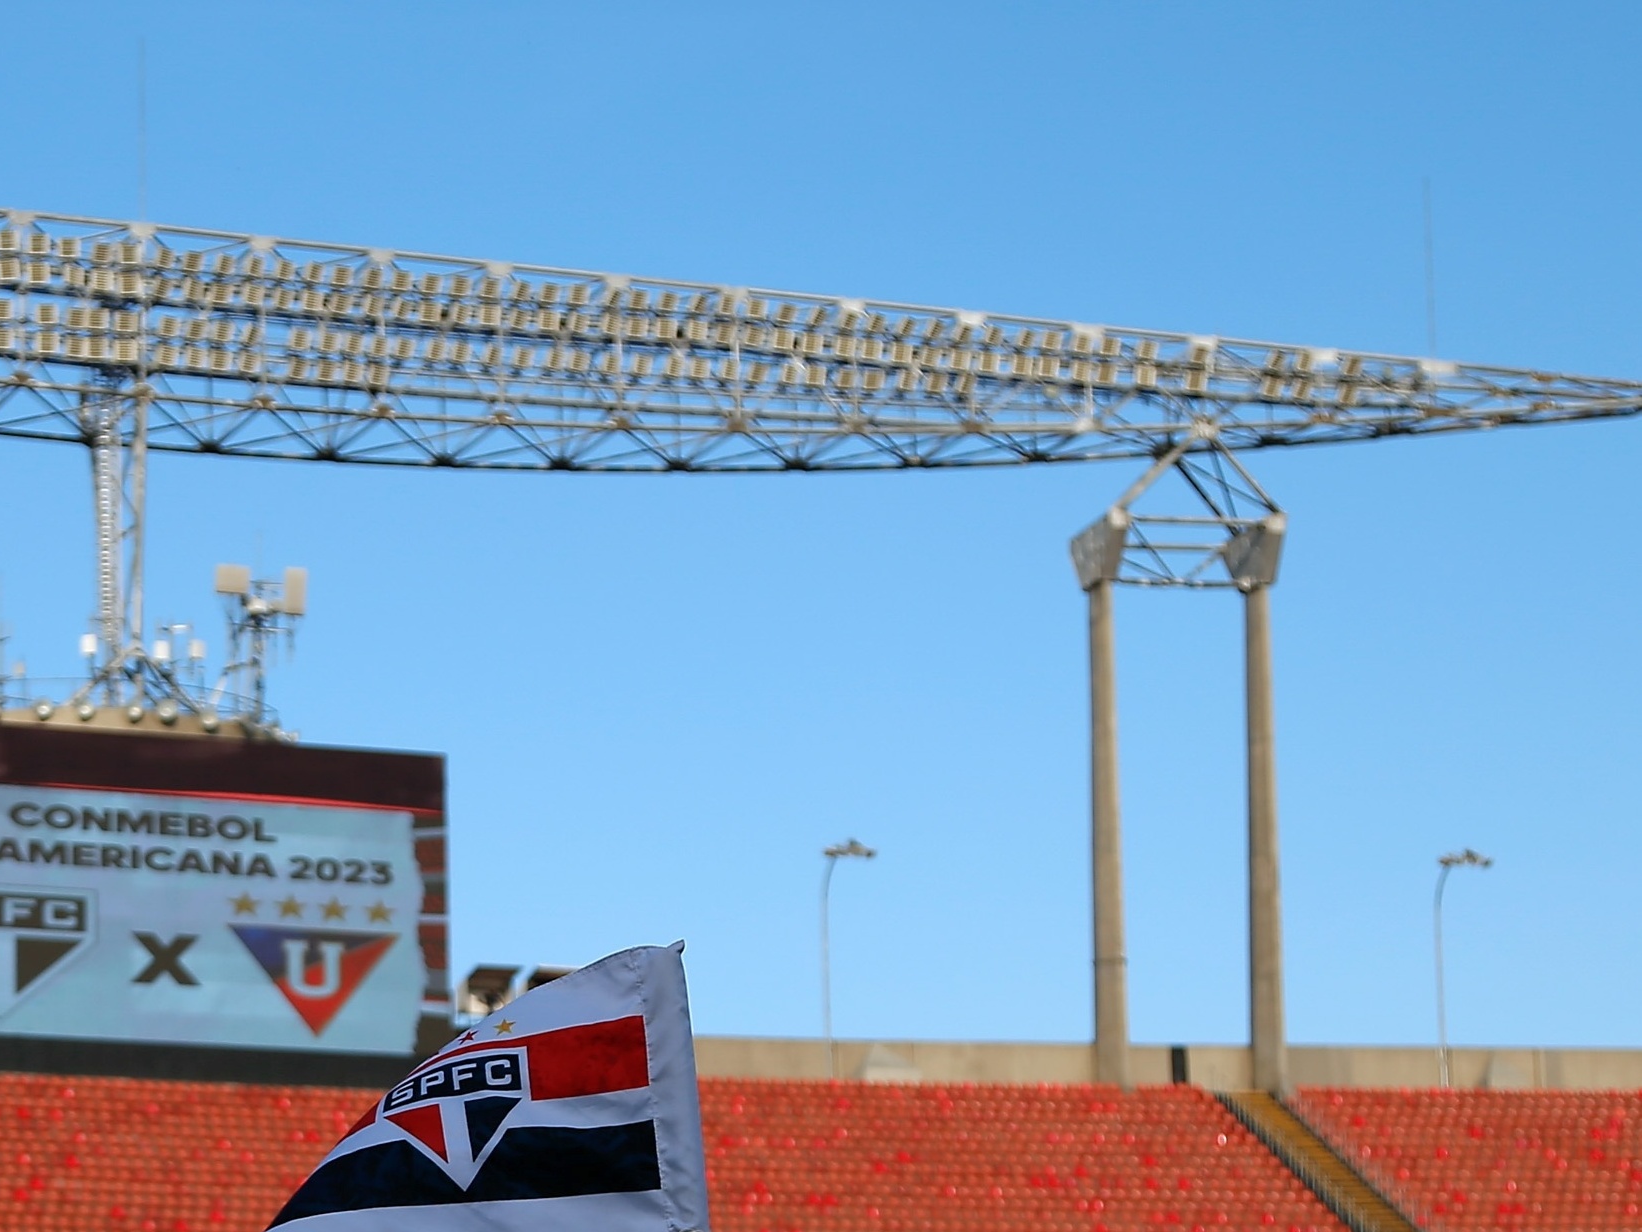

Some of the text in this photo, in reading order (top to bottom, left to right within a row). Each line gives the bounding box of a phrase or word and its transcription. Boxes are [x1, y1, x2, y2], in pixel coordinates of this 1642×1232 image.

[9, 801, 278, 844] CONMEBOL
[289, 856, 394, 886] 2023
[391, 1057, 513, 1107] SPFC
